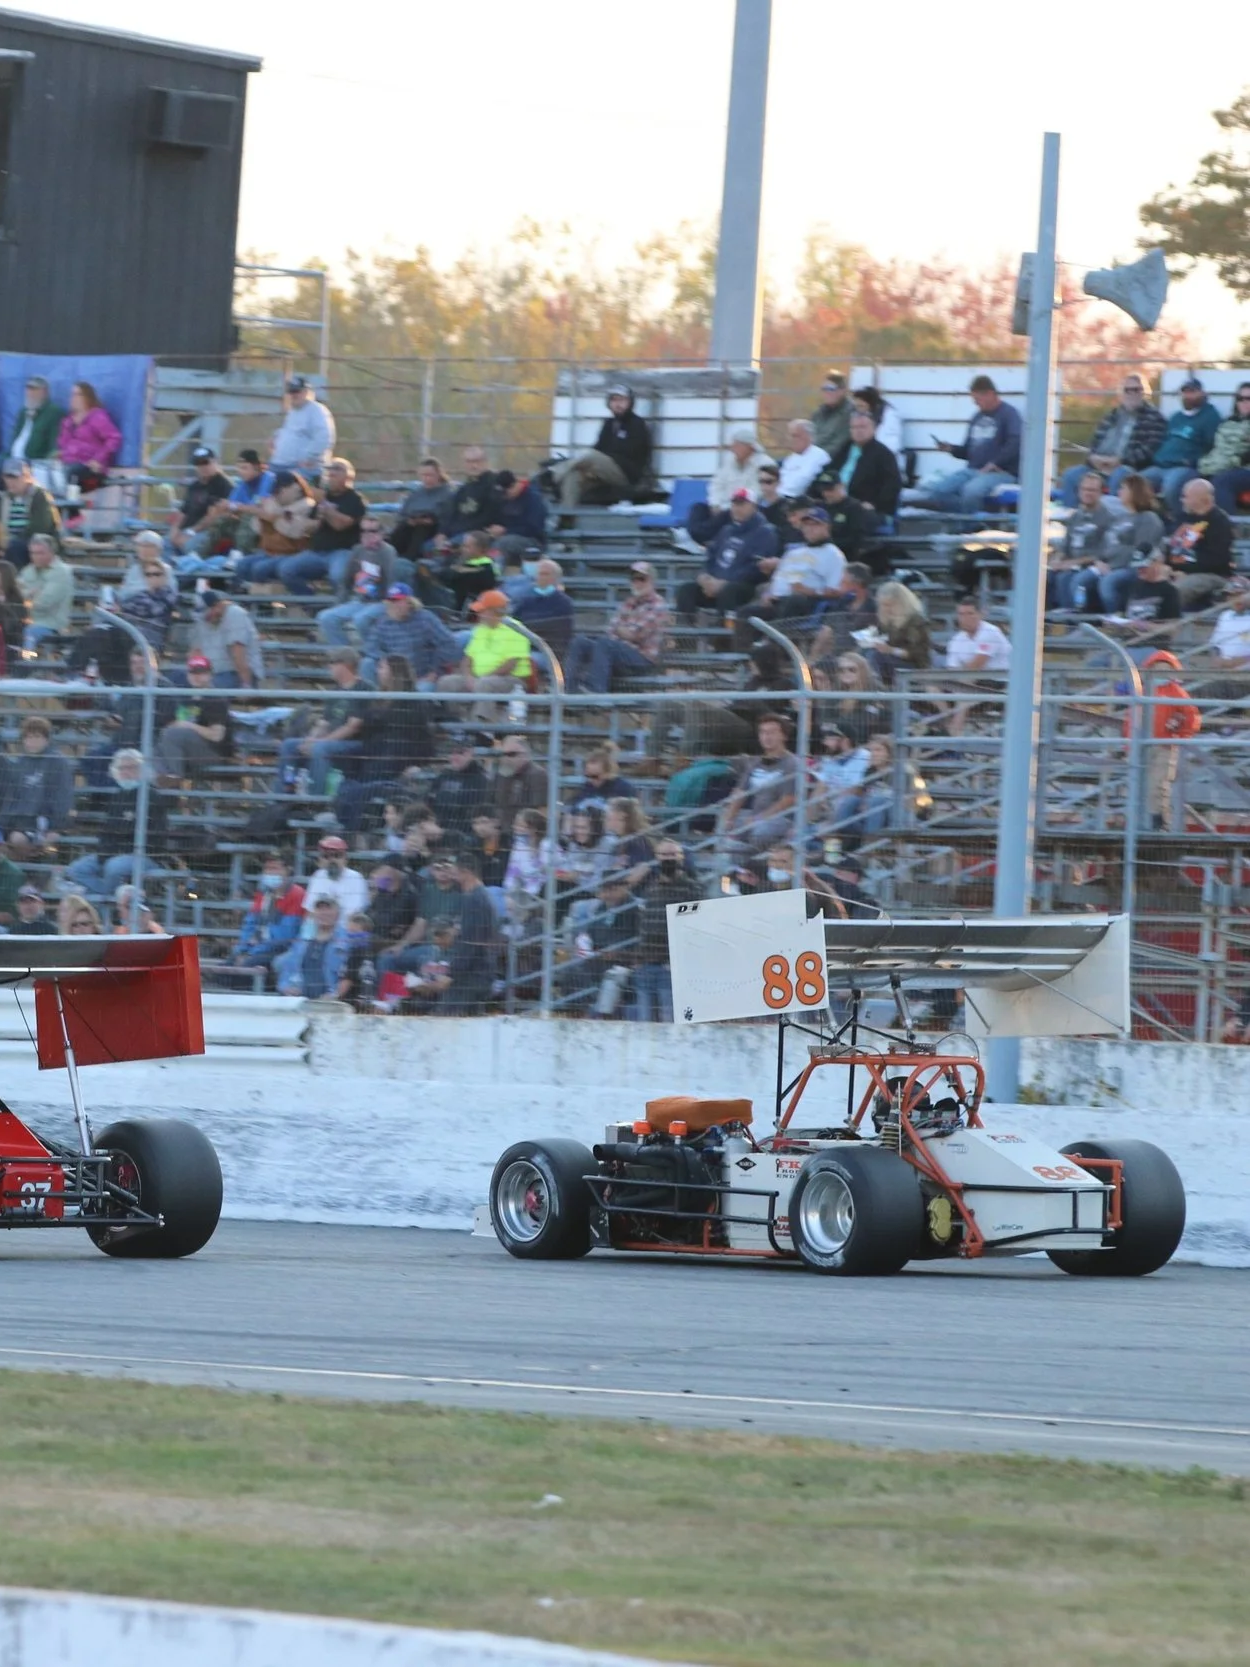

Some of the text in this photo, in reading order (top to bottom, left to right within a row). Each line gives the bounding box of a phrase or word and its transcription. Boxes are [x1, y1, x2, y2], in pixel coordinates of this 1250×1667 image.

[762, 950, 826, 1010] 88
[1032, 1165, 1087, 1181] 88
[20, 1182, 52, 1211] 37
